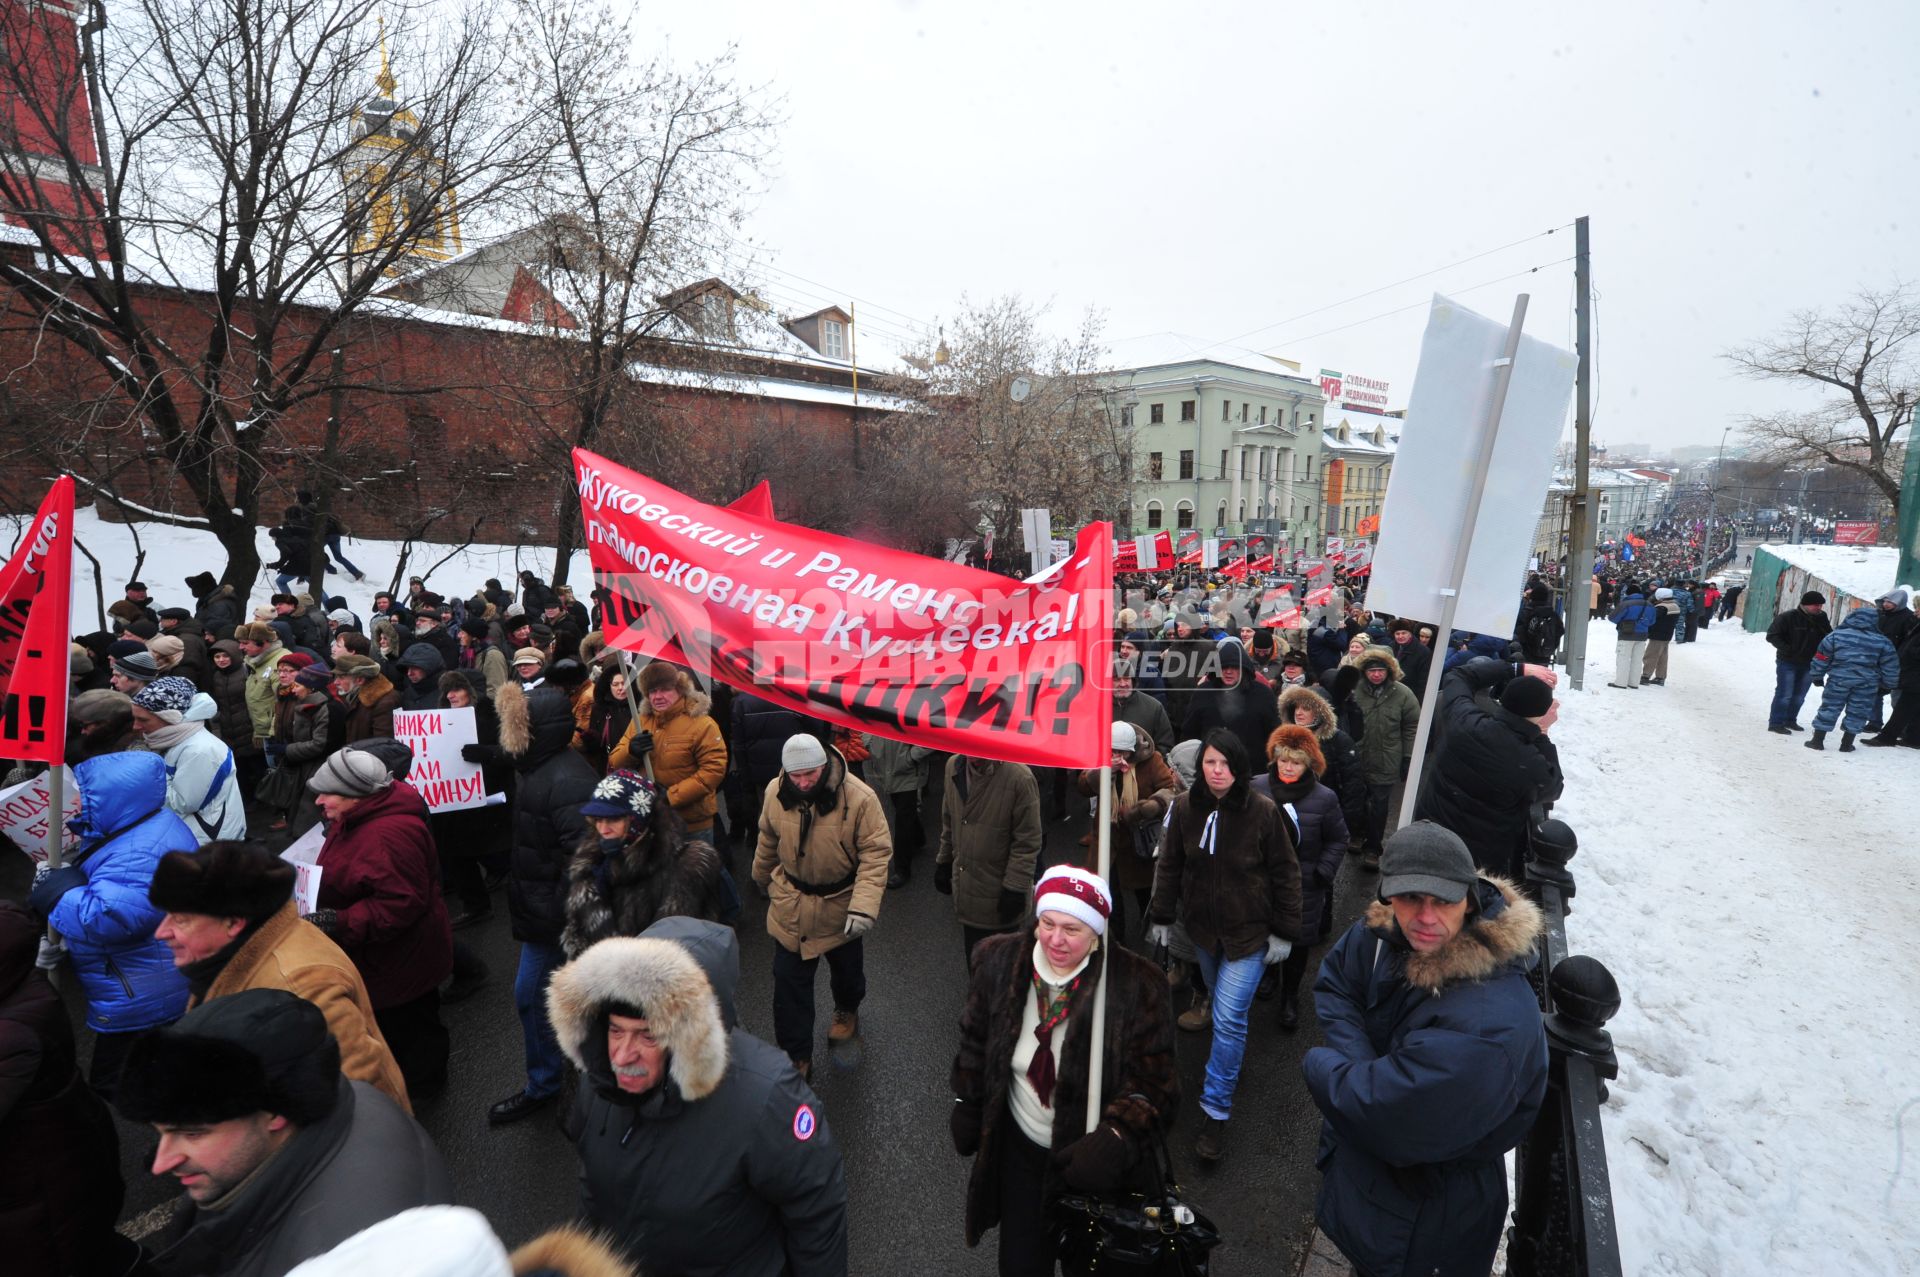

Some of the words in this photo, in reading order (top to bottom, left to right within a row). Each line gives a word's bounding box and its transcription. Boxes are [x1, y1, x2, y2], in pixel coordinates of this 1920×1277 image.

[1345, 389, 1389, 404] НЕДВИЖИМОСТИ
[1346, 374, 1390, 391] СУПЕРМАРКЕТ
[578, 464, 764, 557] Жуковский
[759, 548, 796, 569] и
[587, 518, 816, 634] подмосковная
